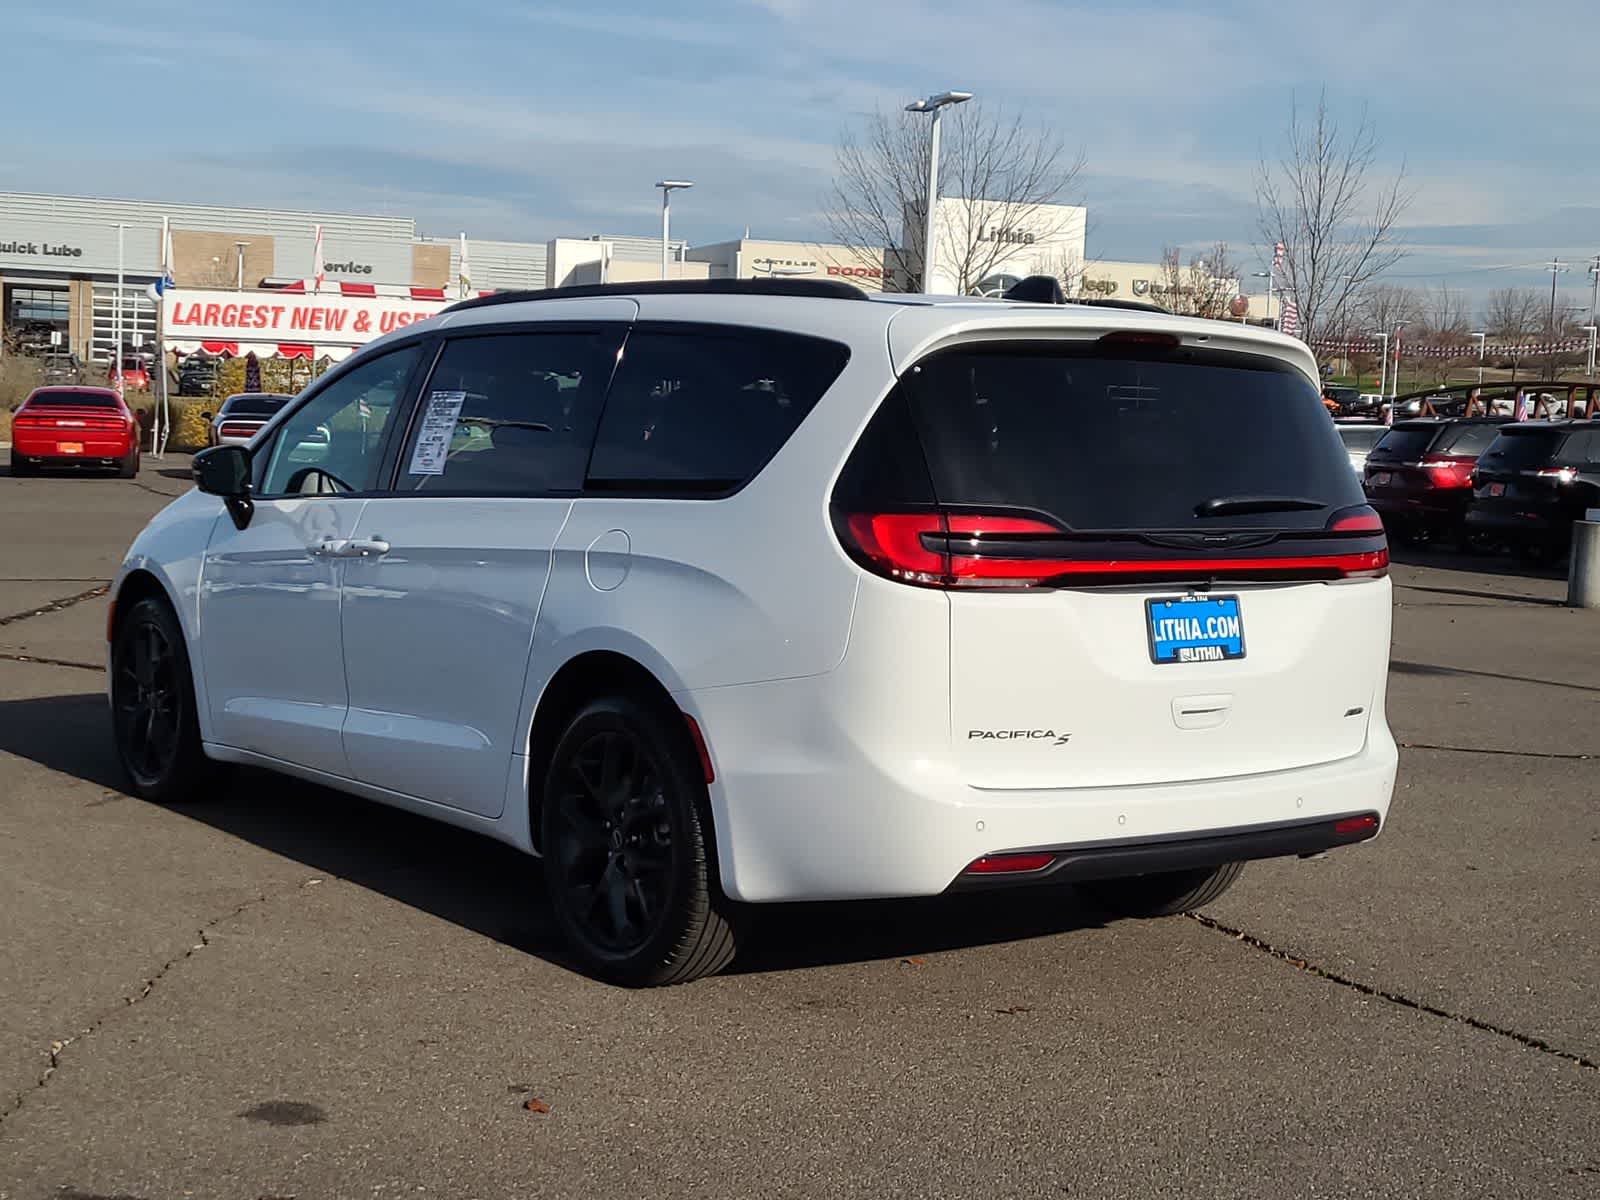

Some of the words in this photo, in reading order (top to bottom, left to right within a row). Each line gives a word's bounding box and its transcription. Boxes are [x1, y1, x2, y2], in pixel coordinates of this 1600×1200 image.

[976, 225, 1035, 245] Lithia
[0, 241, 39, 255] uick
[42, 243, 83, 257] Lube
[322, 260, 373, 274] ervice
[1080, 275, 1118, 295] Jeep
[172, 302, 285, 329] LARGEST
[290, 307, 348, 332] NEW
[353, 309, 371, 333] &
[379, 311, 437, 334] US
[1153, 616, 1240, 642] LITHIA.COM
[1190, 645, 1224, 661] LITHIA
[968, 729, 1056, 740] PACIFICA
[1052, 733, 1072, 746] S
